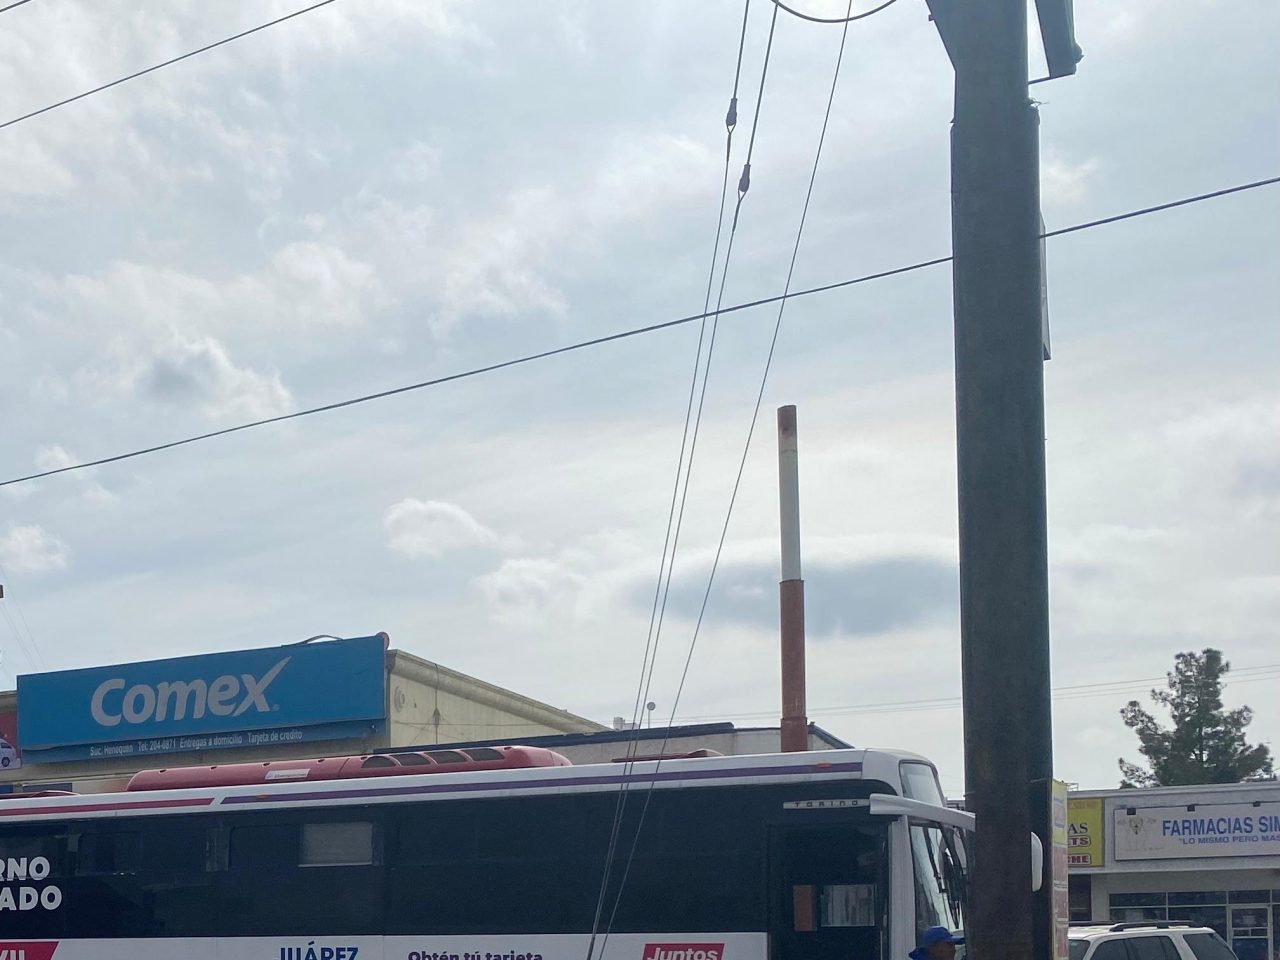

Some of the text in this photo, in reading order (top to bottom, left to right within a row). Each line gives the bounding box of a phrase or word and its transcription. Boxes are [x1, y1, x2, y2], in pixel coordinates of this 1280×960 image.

[91, 656, 292, 726] Comex
[248, 731, 270, 745] Tarjeta
[271, 730, 279, 742] de
[795, 800, 858, 808] TORINO
[1162, 816, 1253, 836] FARMACIAS
[1198, 836, 1229, 845] MISMO
[1232, 835, 1259, 843] PERO
